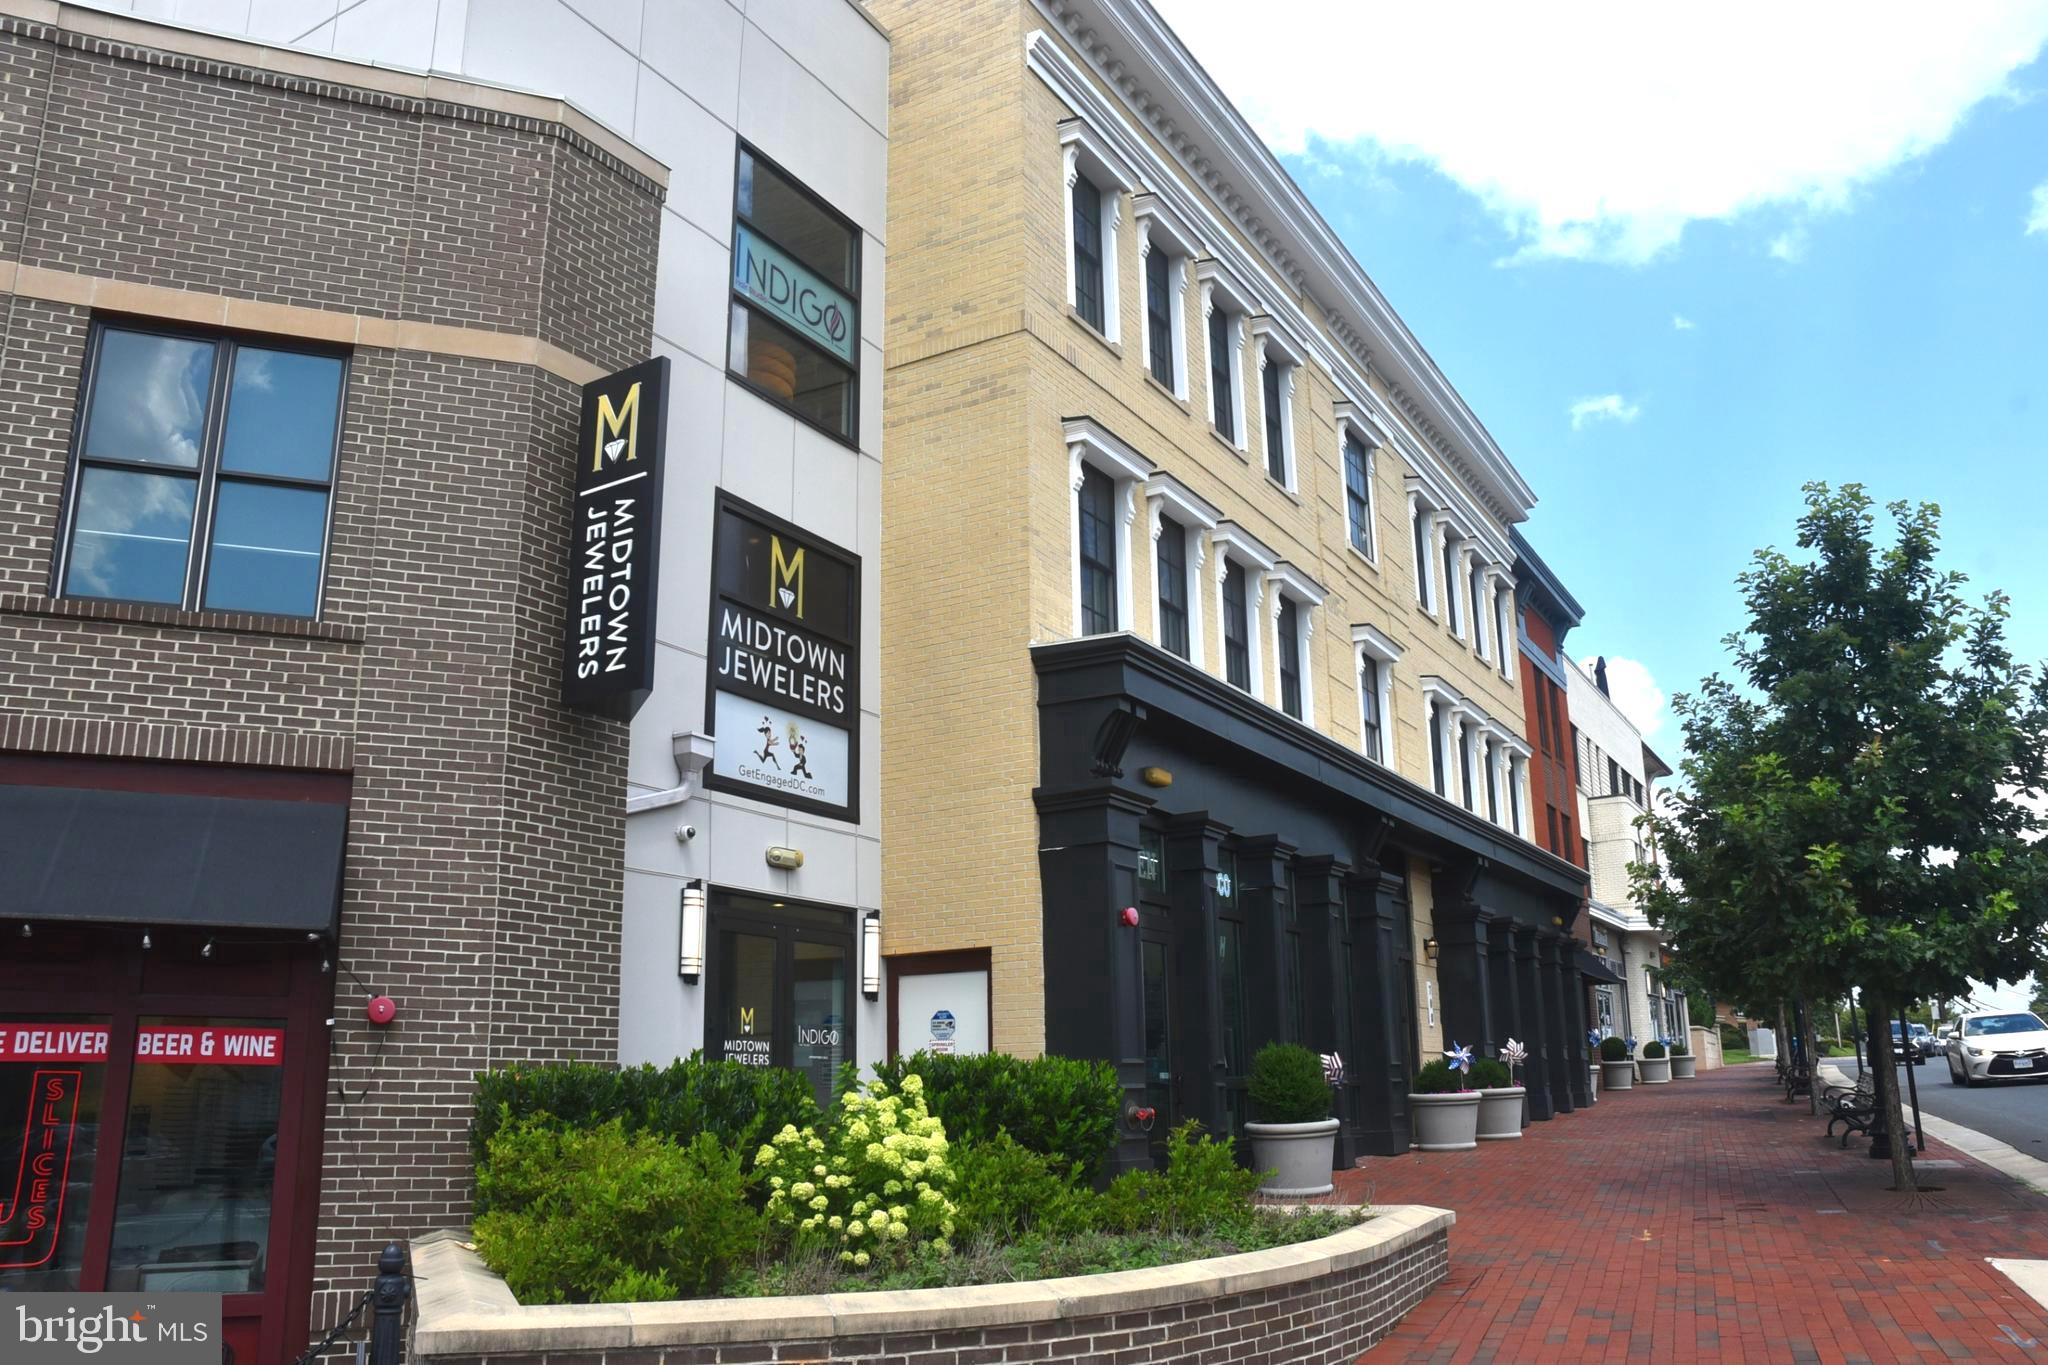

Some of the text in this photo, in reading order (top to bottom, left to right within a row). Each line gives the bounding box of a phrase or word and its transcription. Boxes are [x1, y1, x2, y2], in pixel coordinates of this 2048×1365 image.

[736, 232, 846, 344] INDIGO
[577, 507, 608, 679] JEWELERS
[605, 499, 635, 672] MIDTOWN
[721, 608, 845, 680] MIDTOWN
[719, 646, 845, 714] JEWELERS
[738, 764, 826, 797] GetEngagedDC.com
[14, 1031, 109, 1054] DELIVER
[137, 1032, 277, 1057] BEER & WINE
[723, 1039, 770, 1053] MIDTOWN
[798, 1025, 840, 1046] INDIGO
[26, 1078, 64, 1230] SLICES
